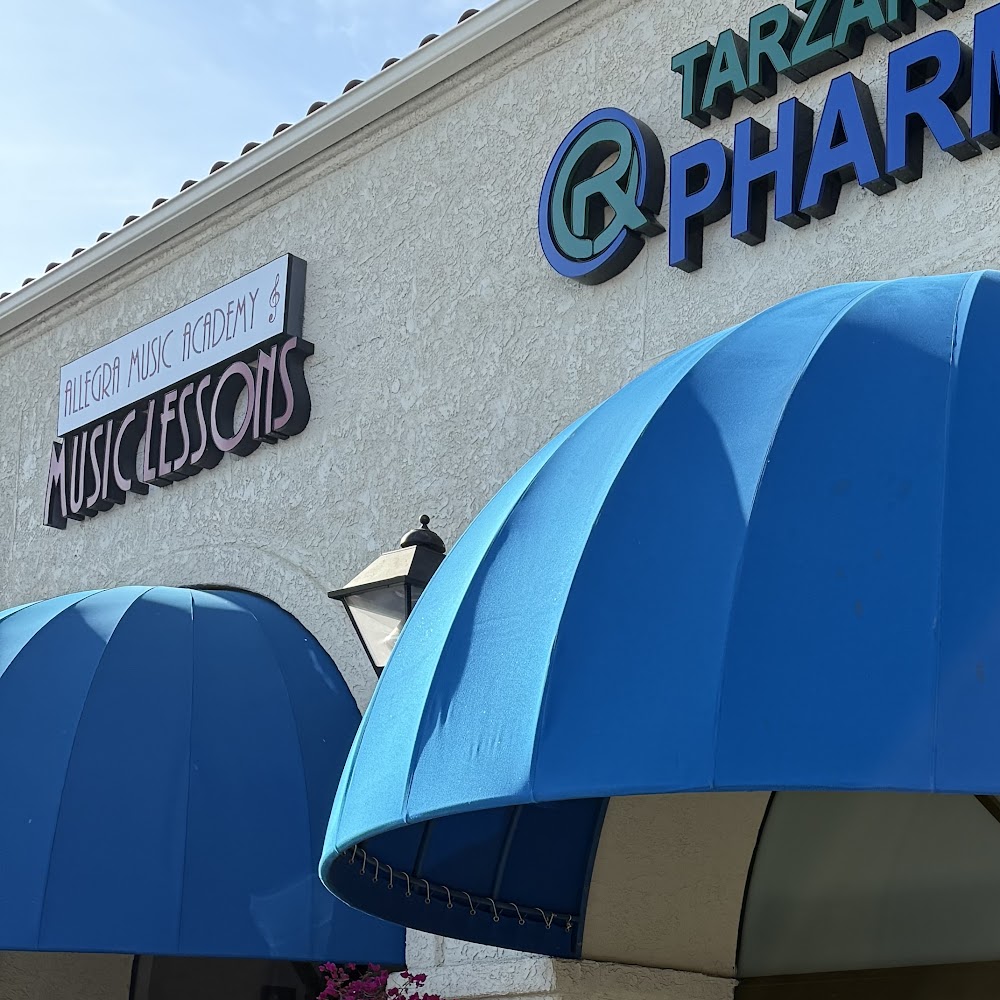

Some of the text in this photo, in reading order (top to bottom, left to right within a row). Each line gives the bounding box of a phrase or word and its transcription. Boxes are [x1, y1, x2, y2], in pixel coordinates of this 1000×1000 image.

[672, 0, 930, 121] TARZA
[64, 288, 260, 418] ALLEGRA MUSIC ACADEMY
[44, 336, 298, 527] MUSIC LESSONS
